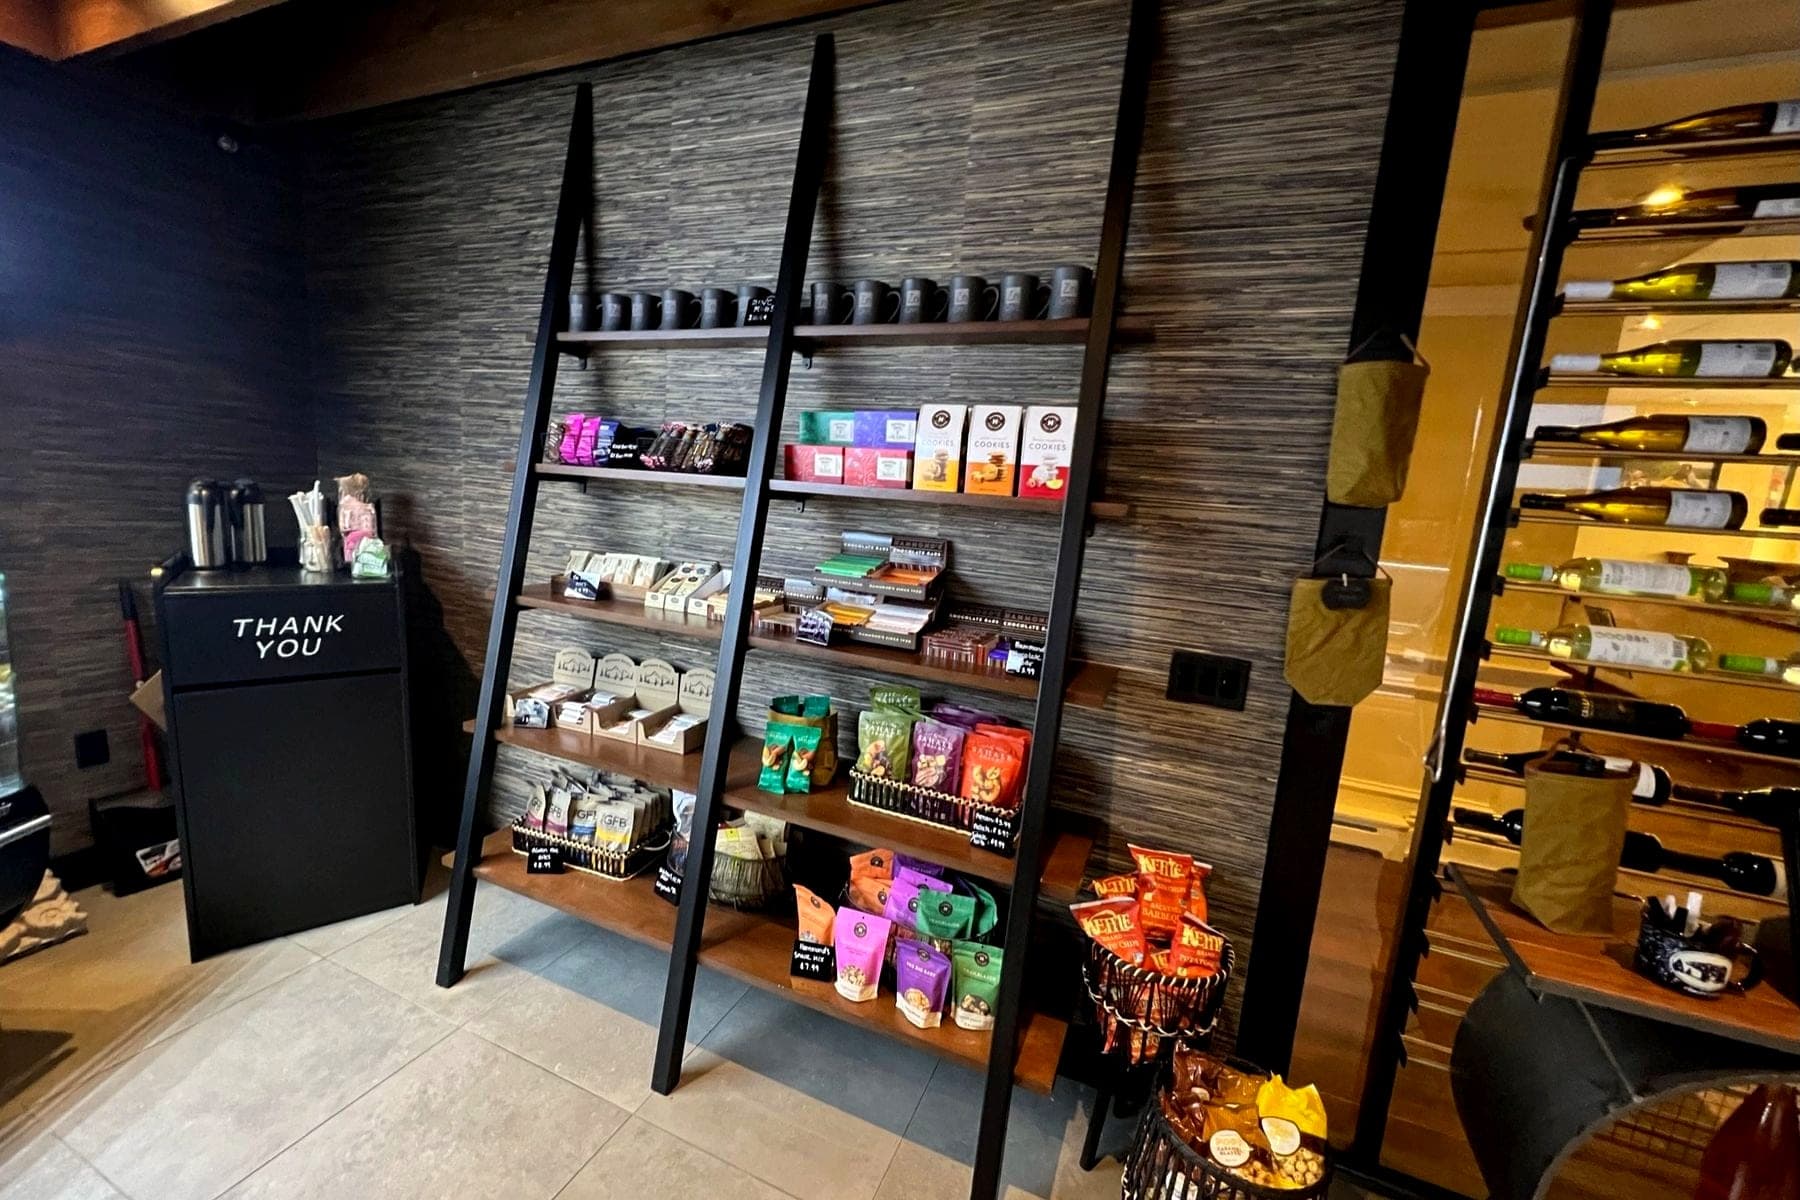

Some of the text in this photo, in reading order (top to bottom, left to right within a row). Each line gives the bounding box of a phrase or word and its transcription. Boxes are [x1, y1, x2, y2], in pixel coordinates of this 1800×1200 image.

[922, 439, 954, 447] COOKIES
[974, 440, 1010, 449] COOKIES
[1028, 443, 1066, 451] COOKIES
[233, 614, 344, 638] THANK
[1003, 621, 1039, 630] CHOCOLATE
[256, 637, 322, 659] YOU
[577, 809, 597, 820] GF
[603, 814, 627, 828] GFB
[1136, 853, 1185, 878] KETTLE
[1081, 913, 1135, 937] KETTLE
